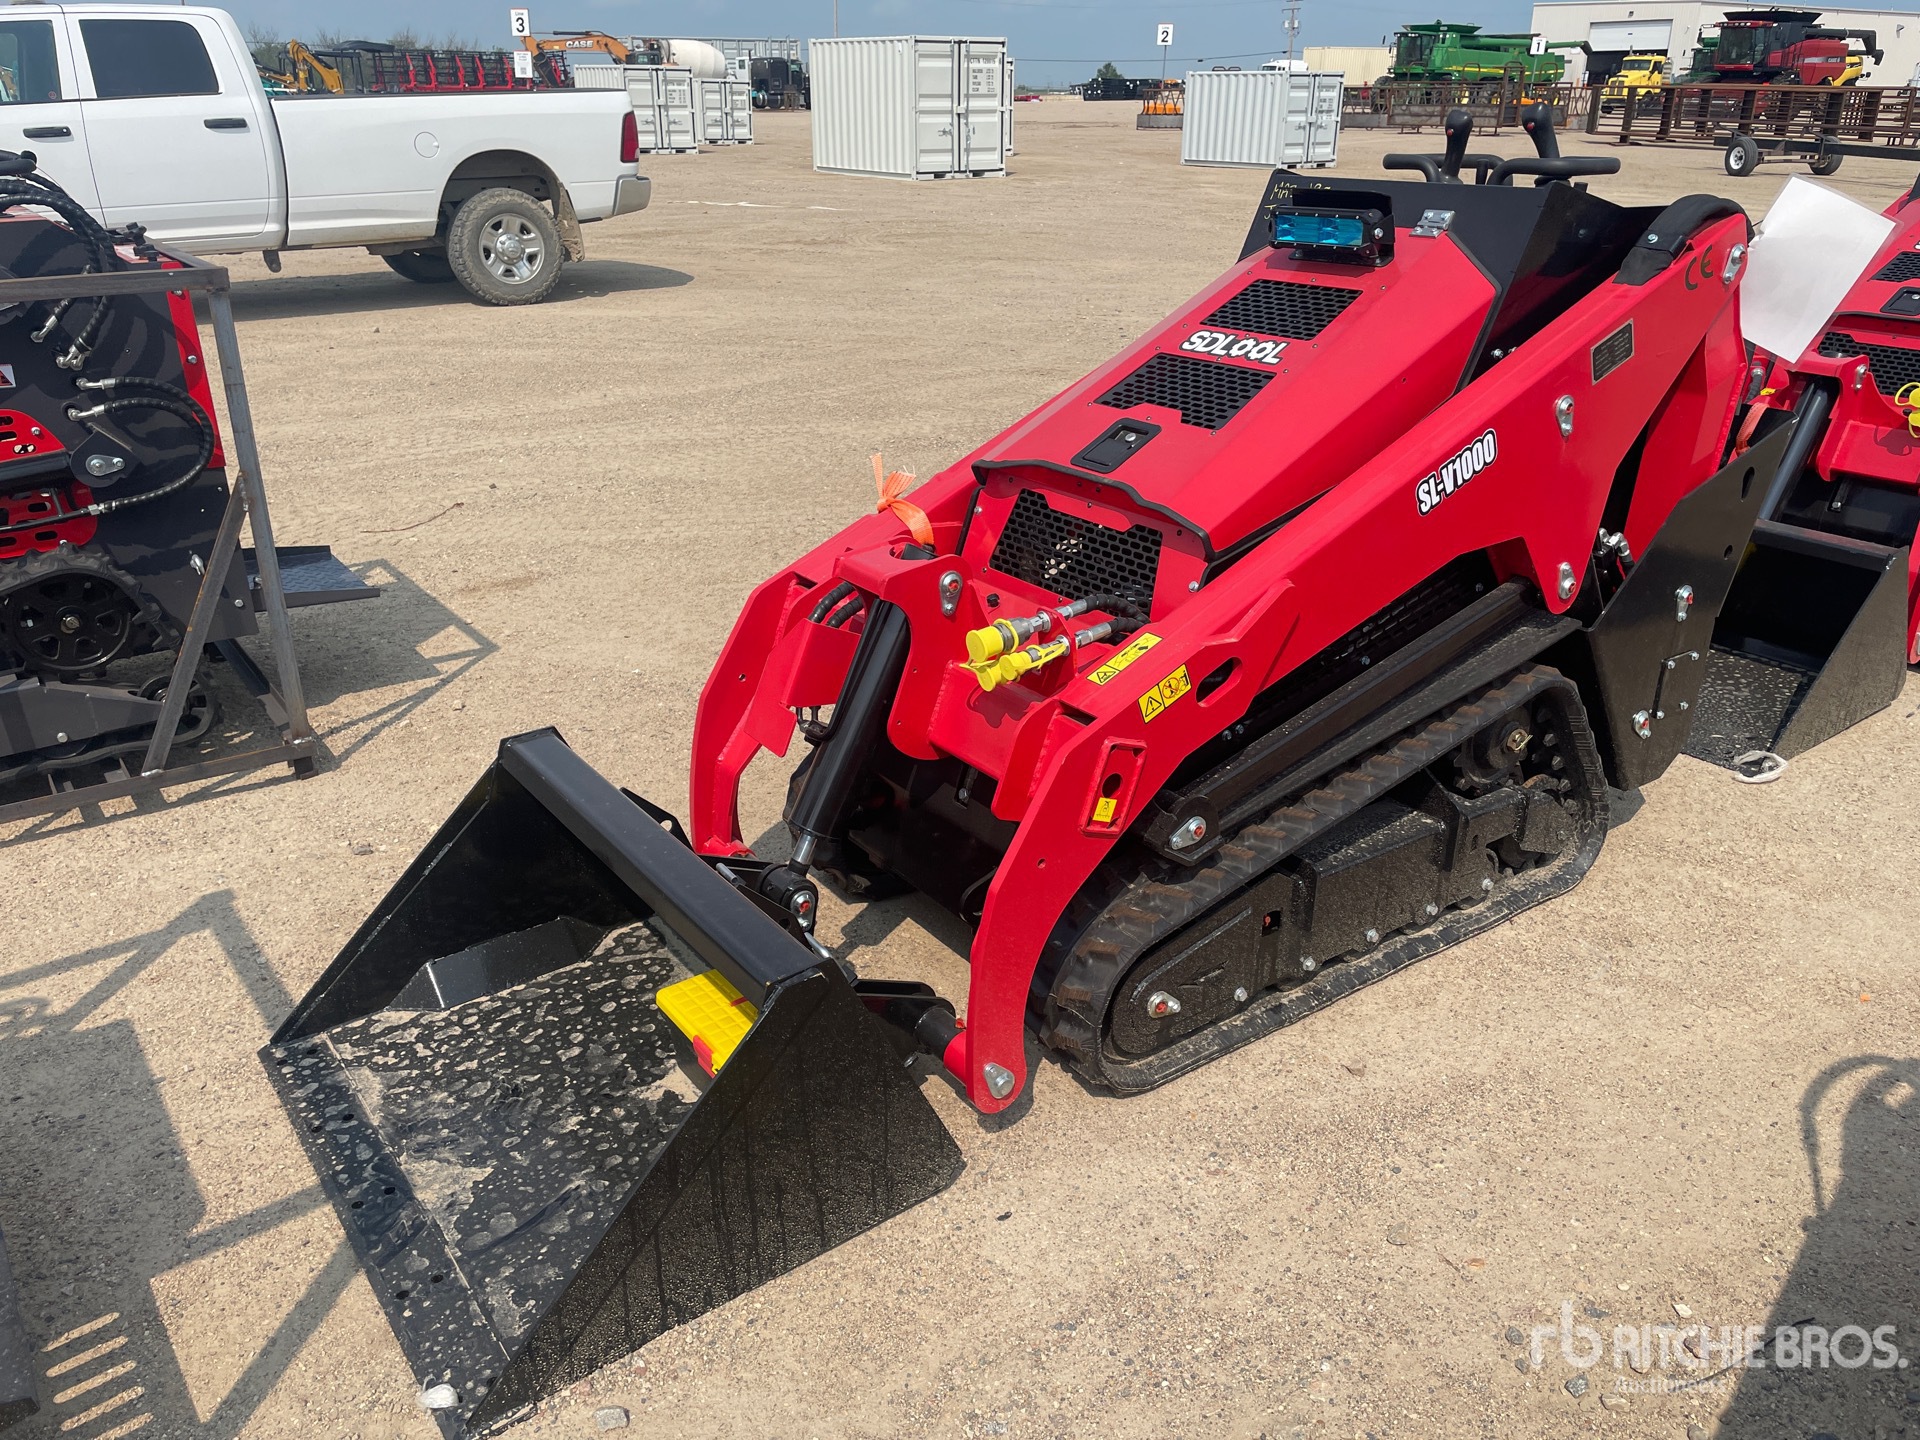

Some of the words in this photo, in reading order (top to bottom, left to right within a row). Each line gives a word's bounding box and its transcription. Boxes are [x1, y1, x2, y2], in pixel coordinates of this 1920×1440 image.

[516, 17, 525, 33] 3
[566, 40, 594, 48] CASE
[1161, 30, 1169, 43] 2
[1536, 42, 1541, 52] 1
[1685, 245, 1713, 290] CE
[1180, 330, 1289, 365] SDLOOL
[1417, 432, 1496, 513] SL-V1000
